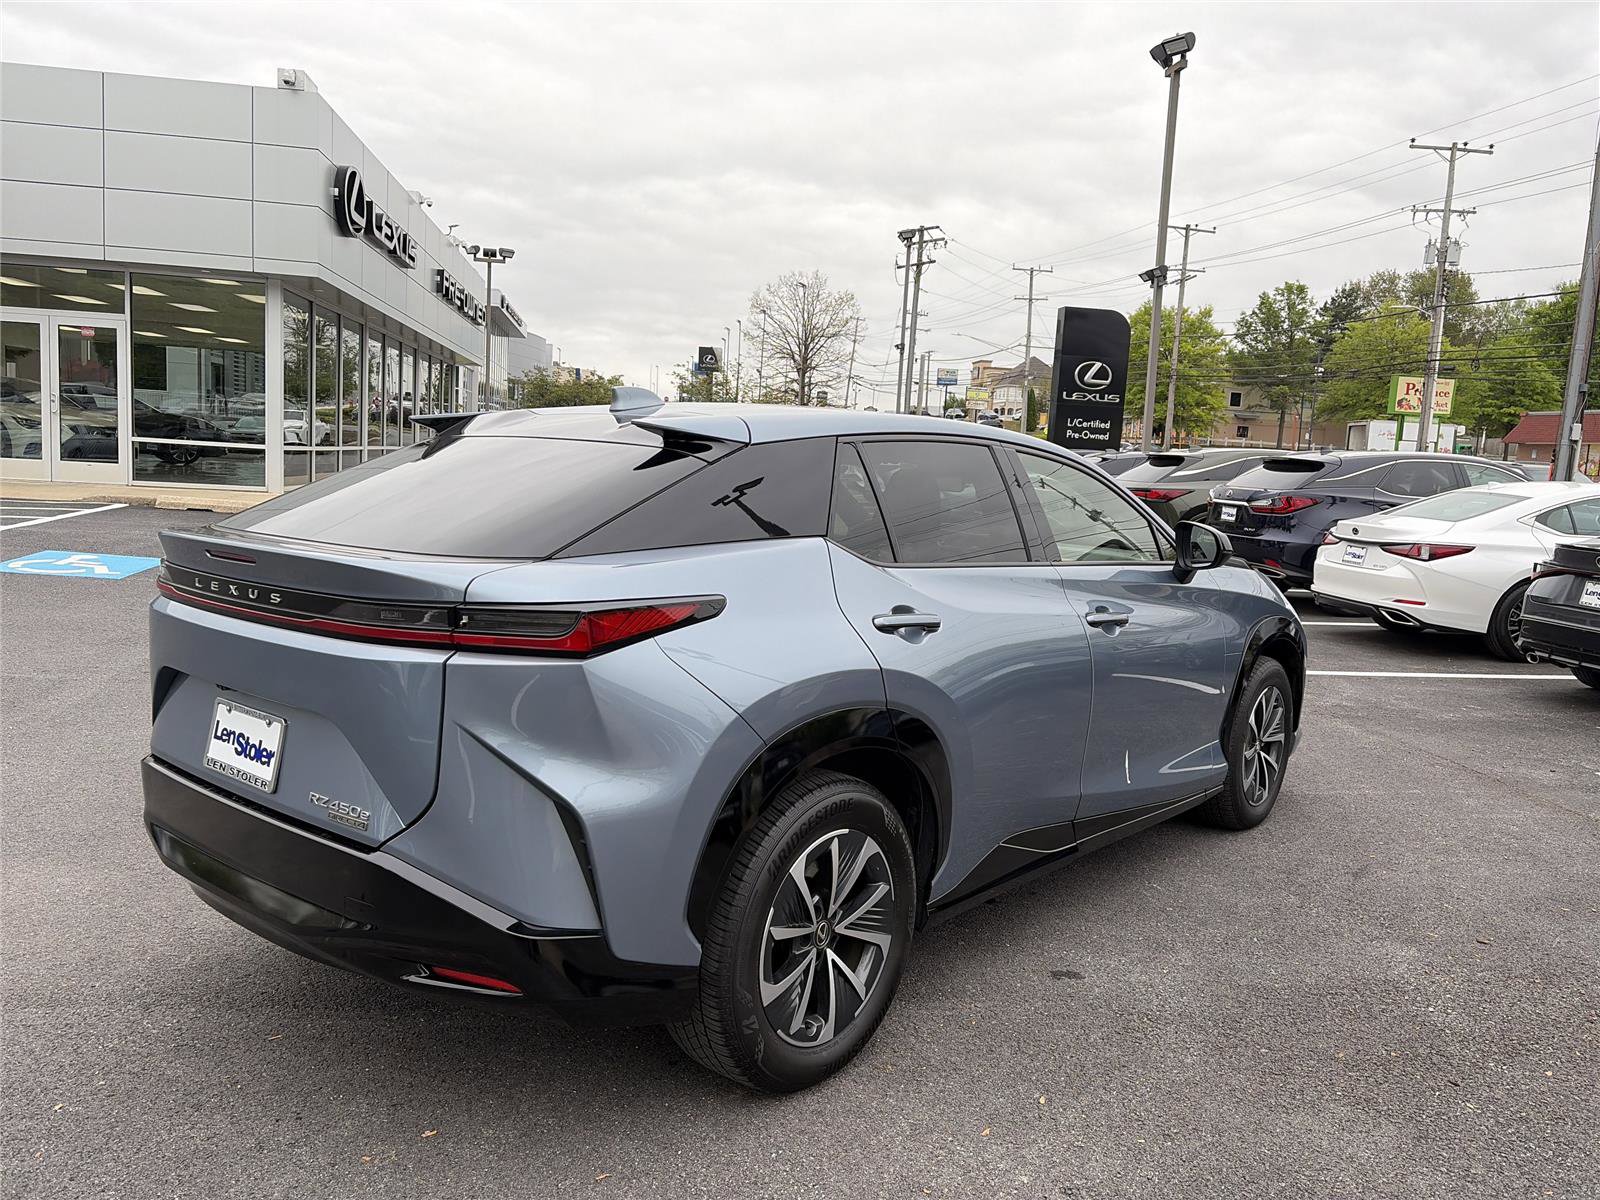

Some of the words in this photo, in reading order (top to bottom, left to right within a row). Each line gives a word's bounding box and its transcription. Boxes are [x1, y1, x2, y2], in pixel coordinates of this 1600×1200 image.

[368, 201, 417, 269] LEXUS
[1062, 391, 1120, 403] LEXUS
[1404, 382, 1450, 398] Prce
[1067, 418, 1111, 429] L/Certified
[1066, 429, 1110, 441] Pre-Owned
[195, 576, 281, 604] LEXUS
[206, 758, 227, 773] LEN
[223, 767, 268, 790] STOLER
